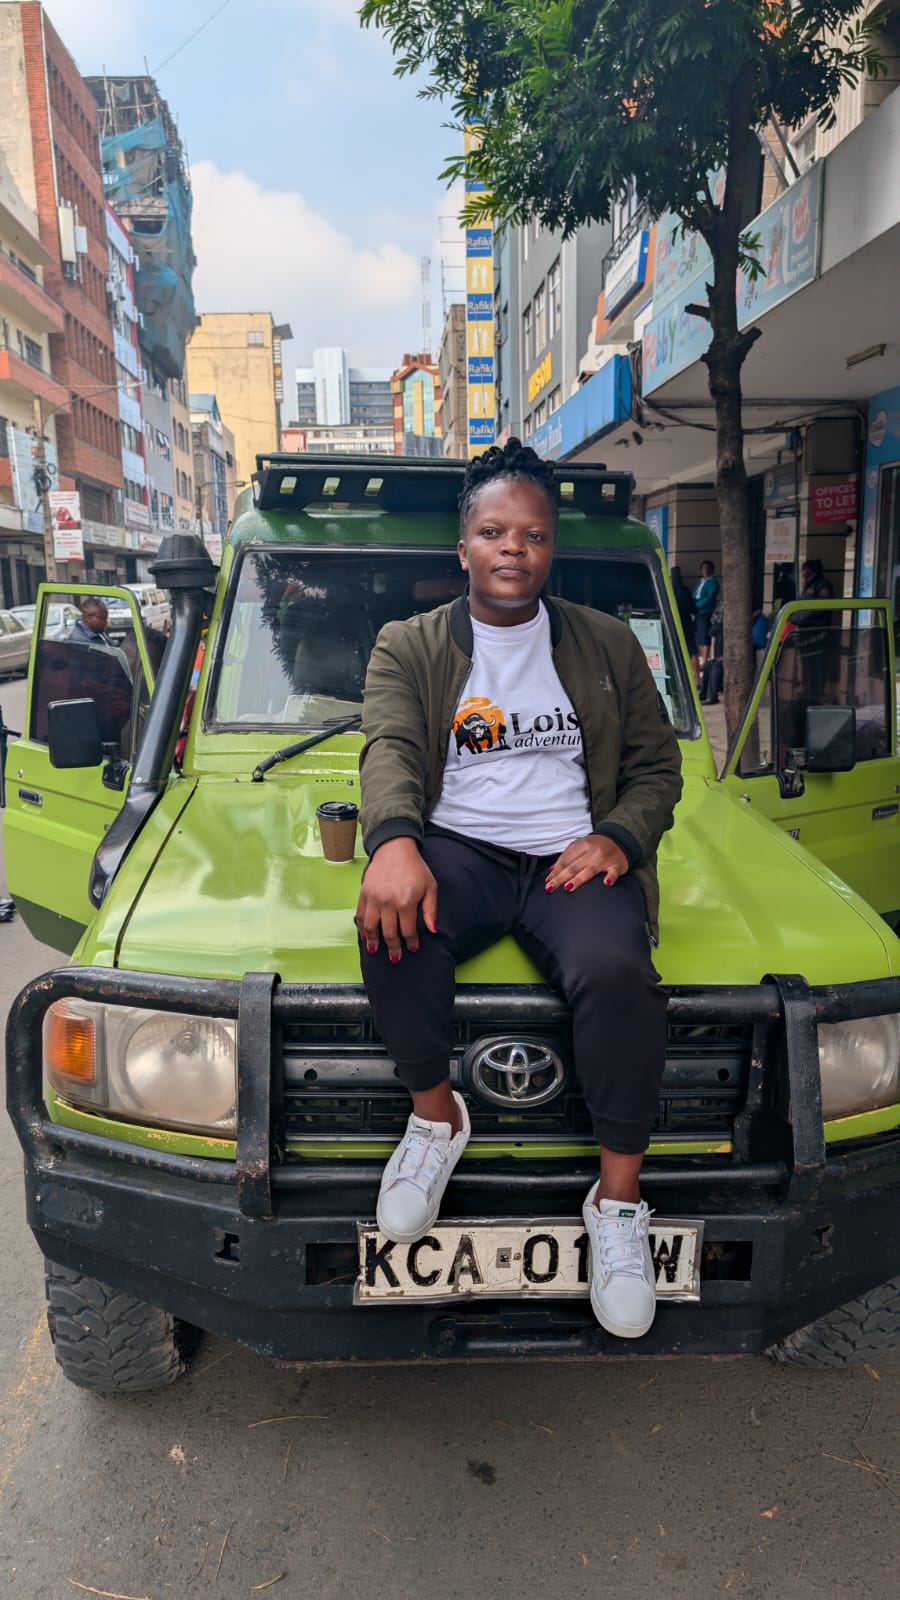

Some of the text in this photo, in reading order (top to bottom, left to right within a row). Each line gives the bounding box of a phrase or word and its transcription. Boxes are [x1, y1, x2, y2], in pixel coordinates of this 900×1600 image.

[467, 236, 492, 247] Rafiki
[468, 300, 494, 311] Rafiki
[469, 363, 495, 374] Rafiki
[470, 425, 496, 435] Rafiki
[816, 485, 857, 497] OFFICES
[816, 494, 857, 509] TO LET
[510, 707, 579, 736] Lois
[365, 1234, 483, 1288] KCA
